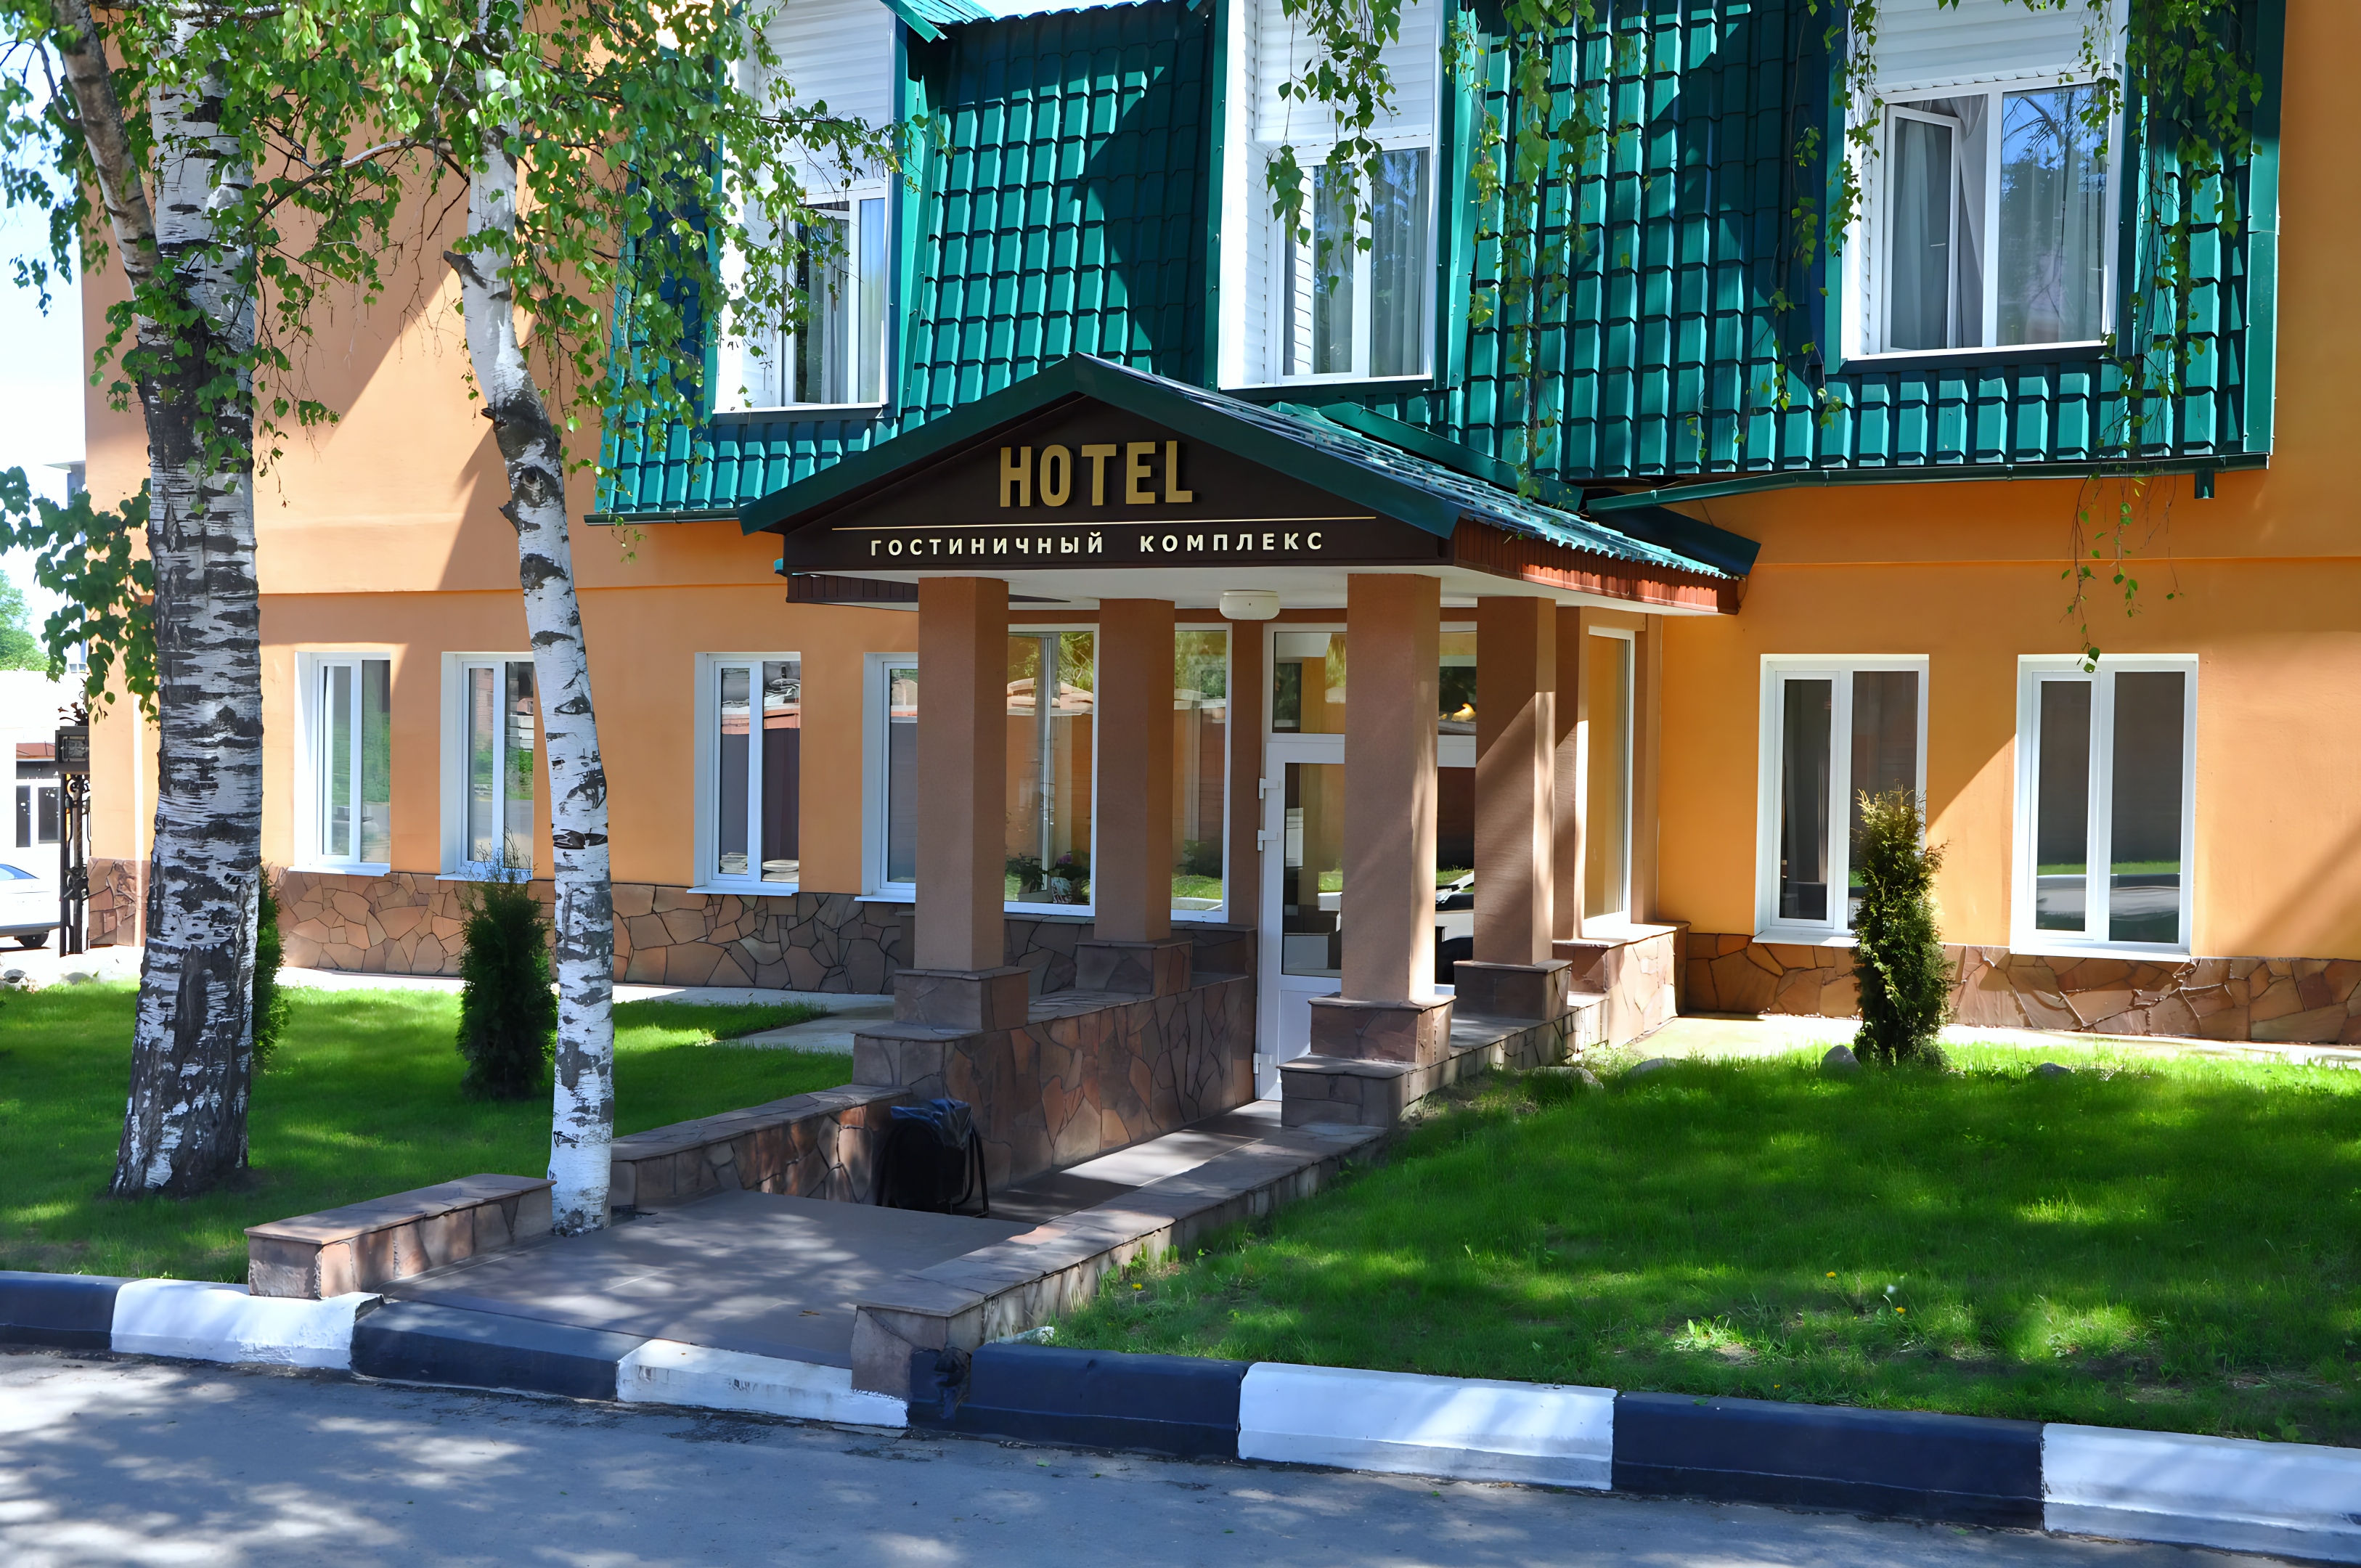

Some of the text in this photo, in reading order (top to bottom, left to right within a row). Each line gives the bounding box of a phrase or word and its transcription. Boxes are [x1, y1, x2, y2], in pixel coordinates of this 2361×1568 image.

[1000, 440, 1194, 507] HOTEL
[870, 531, 1323, 556] ГОСТИНИЧНЫЙ КОМПЛЕКС
